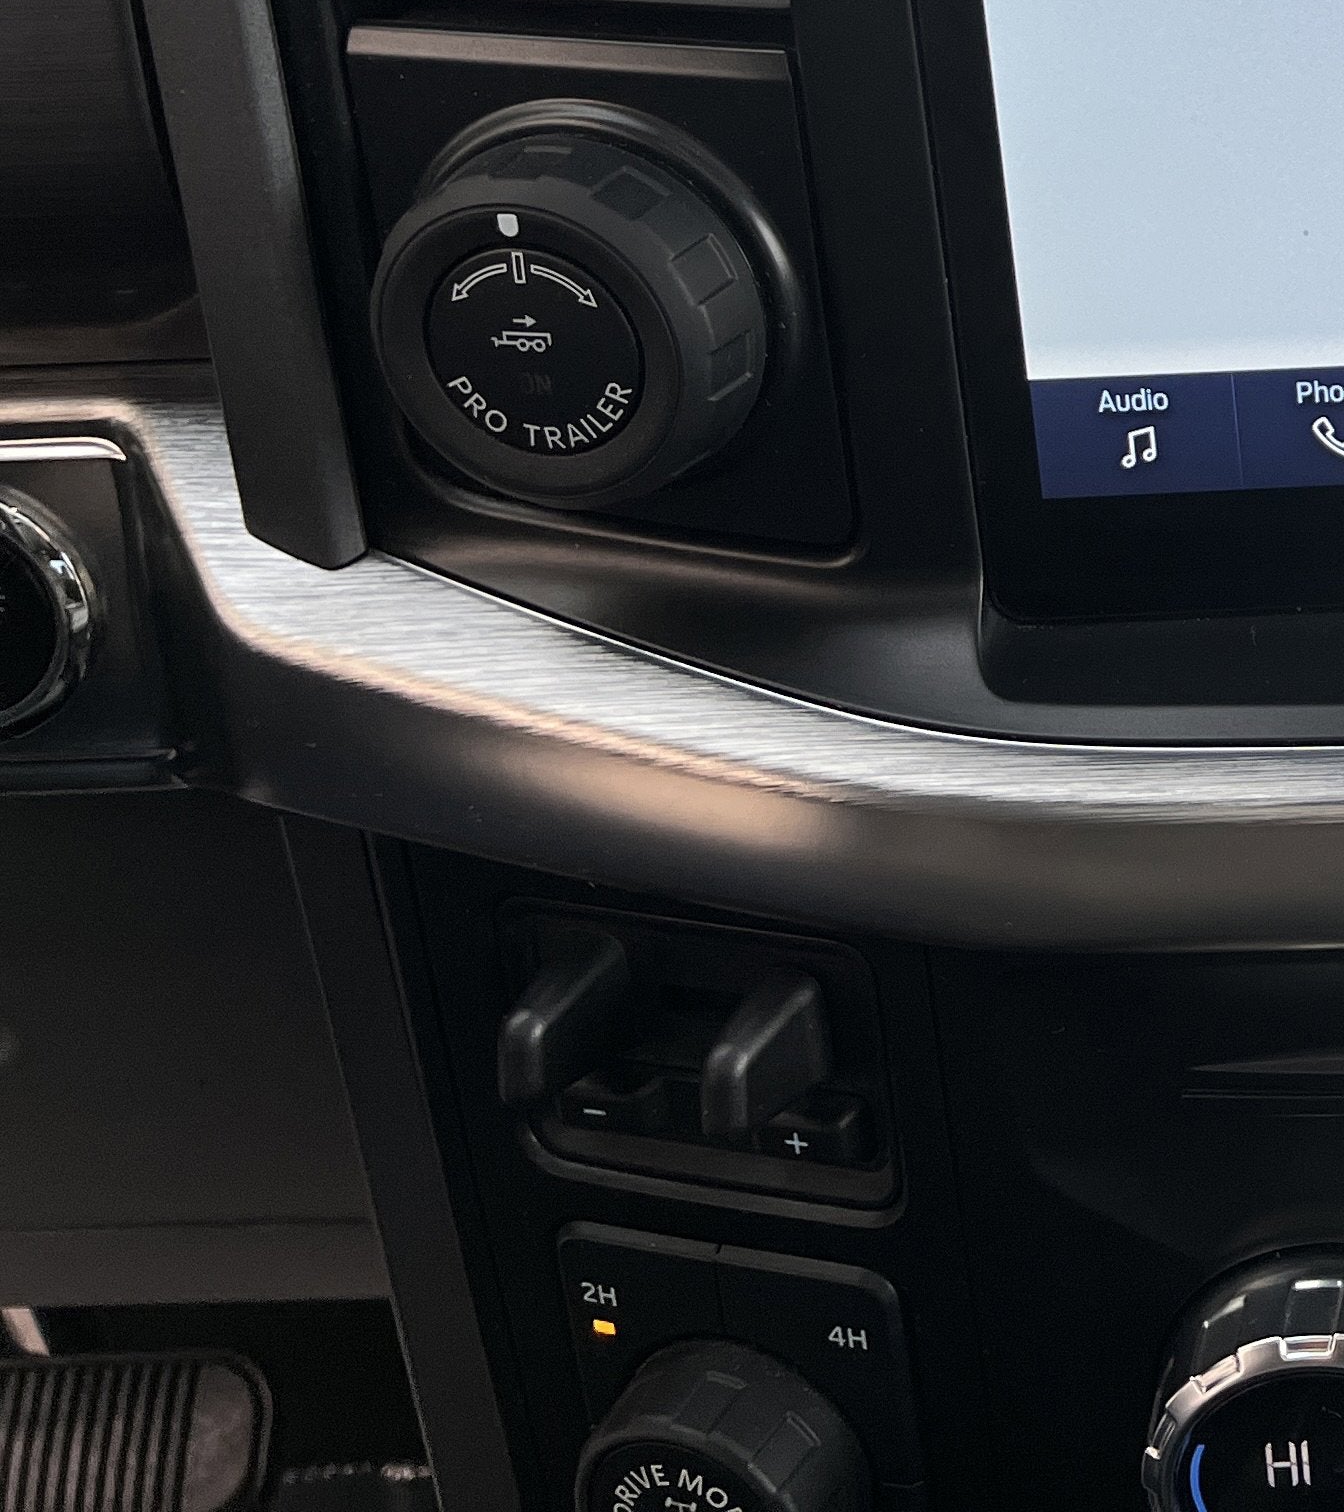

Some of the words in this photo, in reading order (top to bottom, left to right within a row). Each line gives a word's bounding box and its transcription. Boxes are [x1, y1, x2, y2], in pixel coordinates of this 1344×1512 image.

[447, 376, 508, 433] PRO
[522, 382, 633, 449] TRAILER
[1098, 387, 1169, 413] Audio
[580, 1281, 618, 1307] 2H
[828, 1326, 868, 1350] 4H
[1264, 1440, 1311, 1488] HI
[613, 1464, 671, 1512] DRIVE
